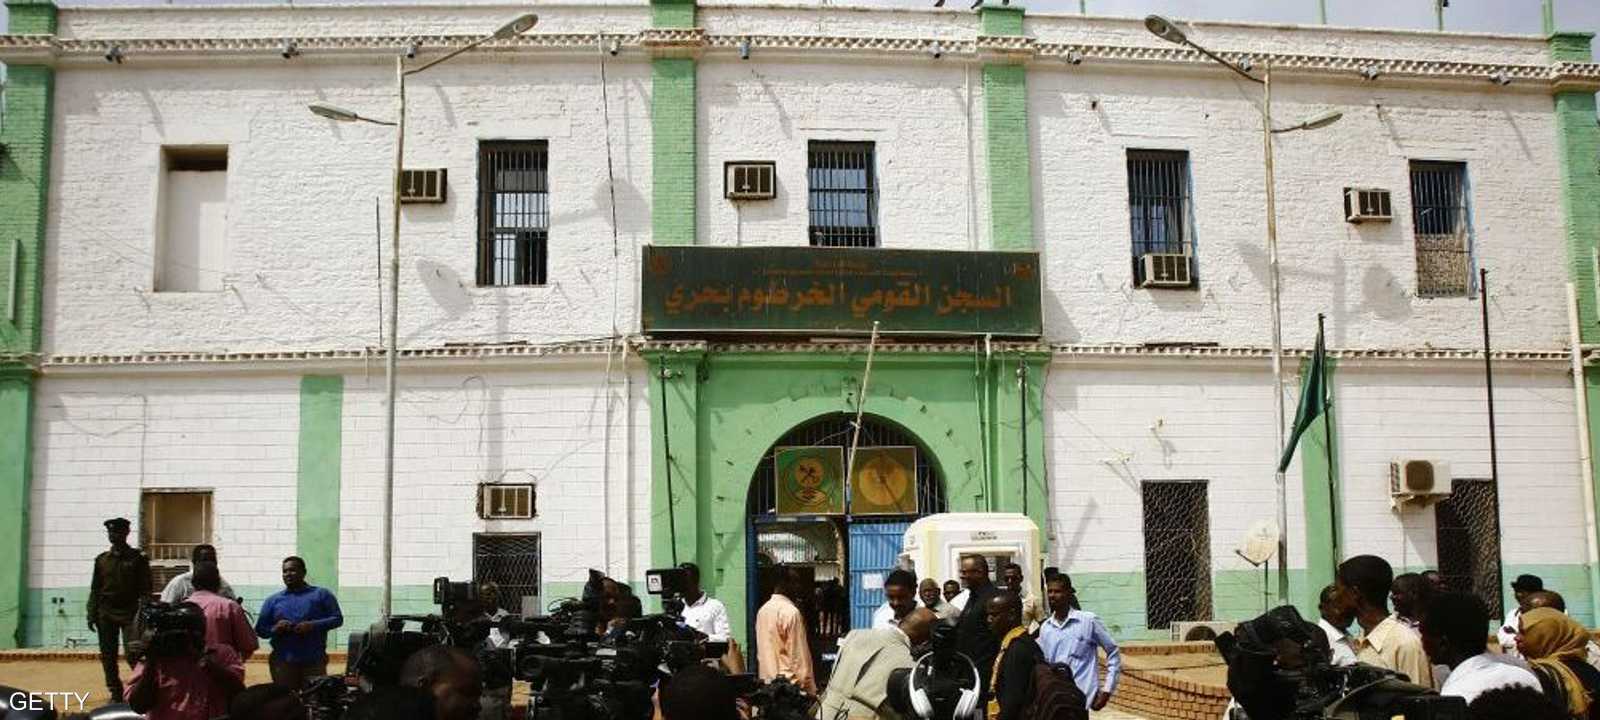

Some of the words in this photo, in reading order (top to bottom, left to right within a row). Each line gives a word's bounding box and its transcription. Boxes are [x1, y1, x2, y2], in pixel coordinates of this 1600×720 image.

[664, 284, 733, 315] بحري
[739, 281, 845, 312] الخرطوم
[850, 281, 931, 316] القومي
[938, 284, 1012, 314] السجن
